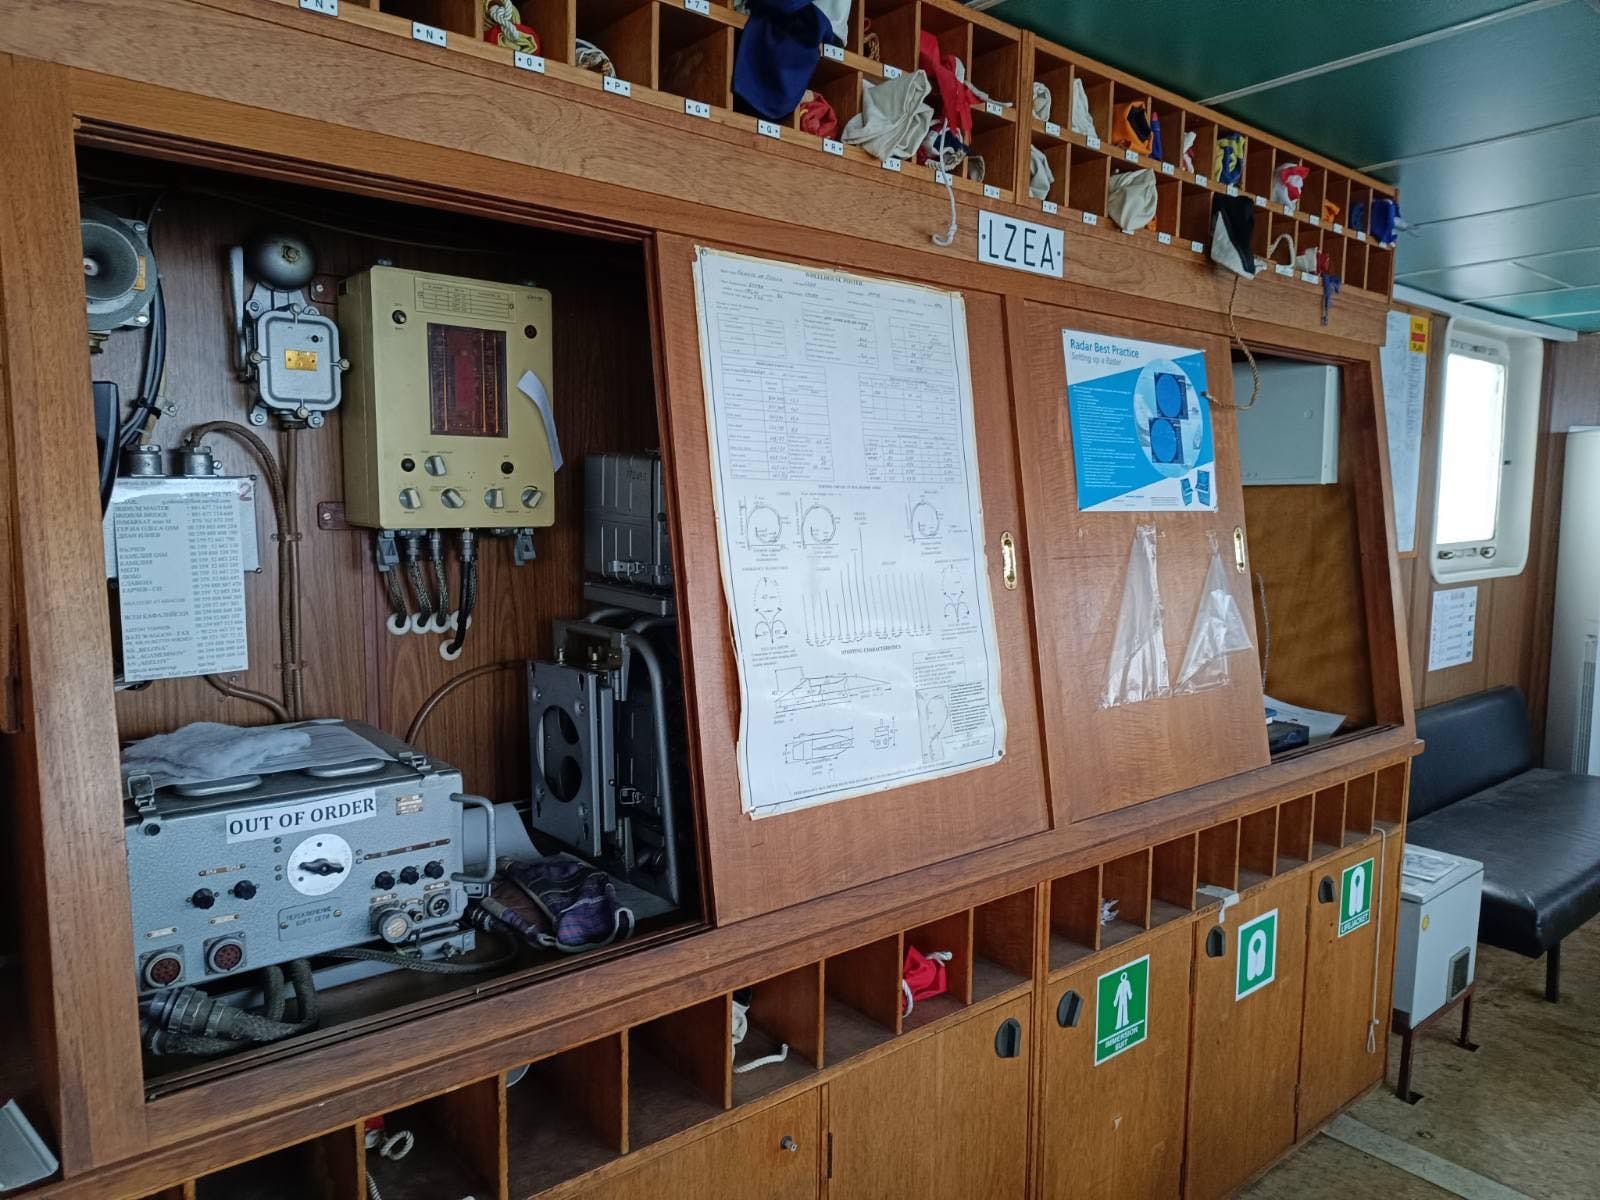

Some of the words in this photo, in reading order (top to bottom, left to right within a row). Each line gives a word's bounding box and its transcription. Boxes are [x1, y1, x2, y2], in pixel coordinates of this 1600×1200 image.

[426, 29, 433, 39] N
[989, 219, 1054, 271] LZEA
[1070, 338, 1092, 352] Radar
[1094, 342, 1110, 354] Best
[1111, 346, 1140, 359] Practice
[1071, 352, 1092, 364] Setting
[1106, 357, 1122, 366] Radar
[239, 482, 252, 502] 2
[229, 815, 273, 835] OUT
[278, 811, 305, 828] OF
[310, 798, 375, 823] ORDER
[1104, 1025, 1139, 1049] IMMERSION
[1114, 1038, 1129, 1051] SUIT
